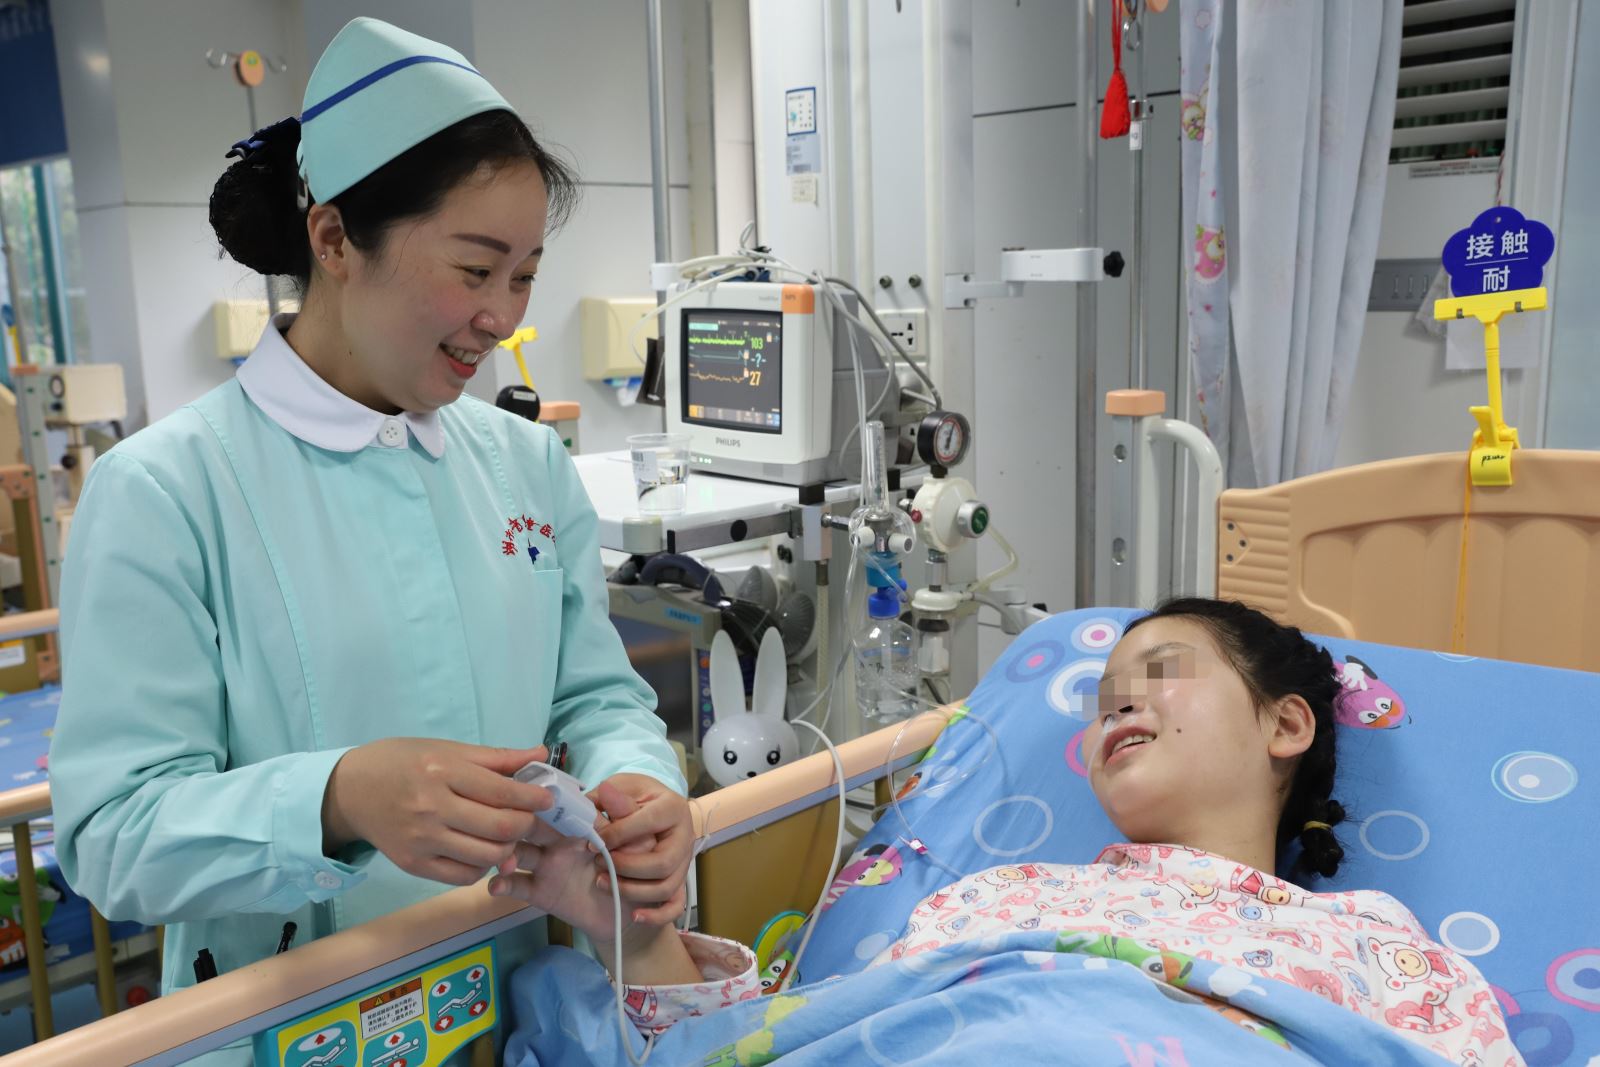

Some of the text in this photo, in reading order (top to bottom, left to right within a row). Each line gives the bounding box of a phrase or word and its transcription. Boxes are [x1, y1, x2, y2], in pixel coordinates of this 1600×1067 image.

[1466, 228, 1529, 260] 接触
[1483, 265, 1511, 292] 耐
[750, 337, 764, 350] 103
[749, 371, 761, 386] 27
[715, 436, 741, 448] PHILIPS
